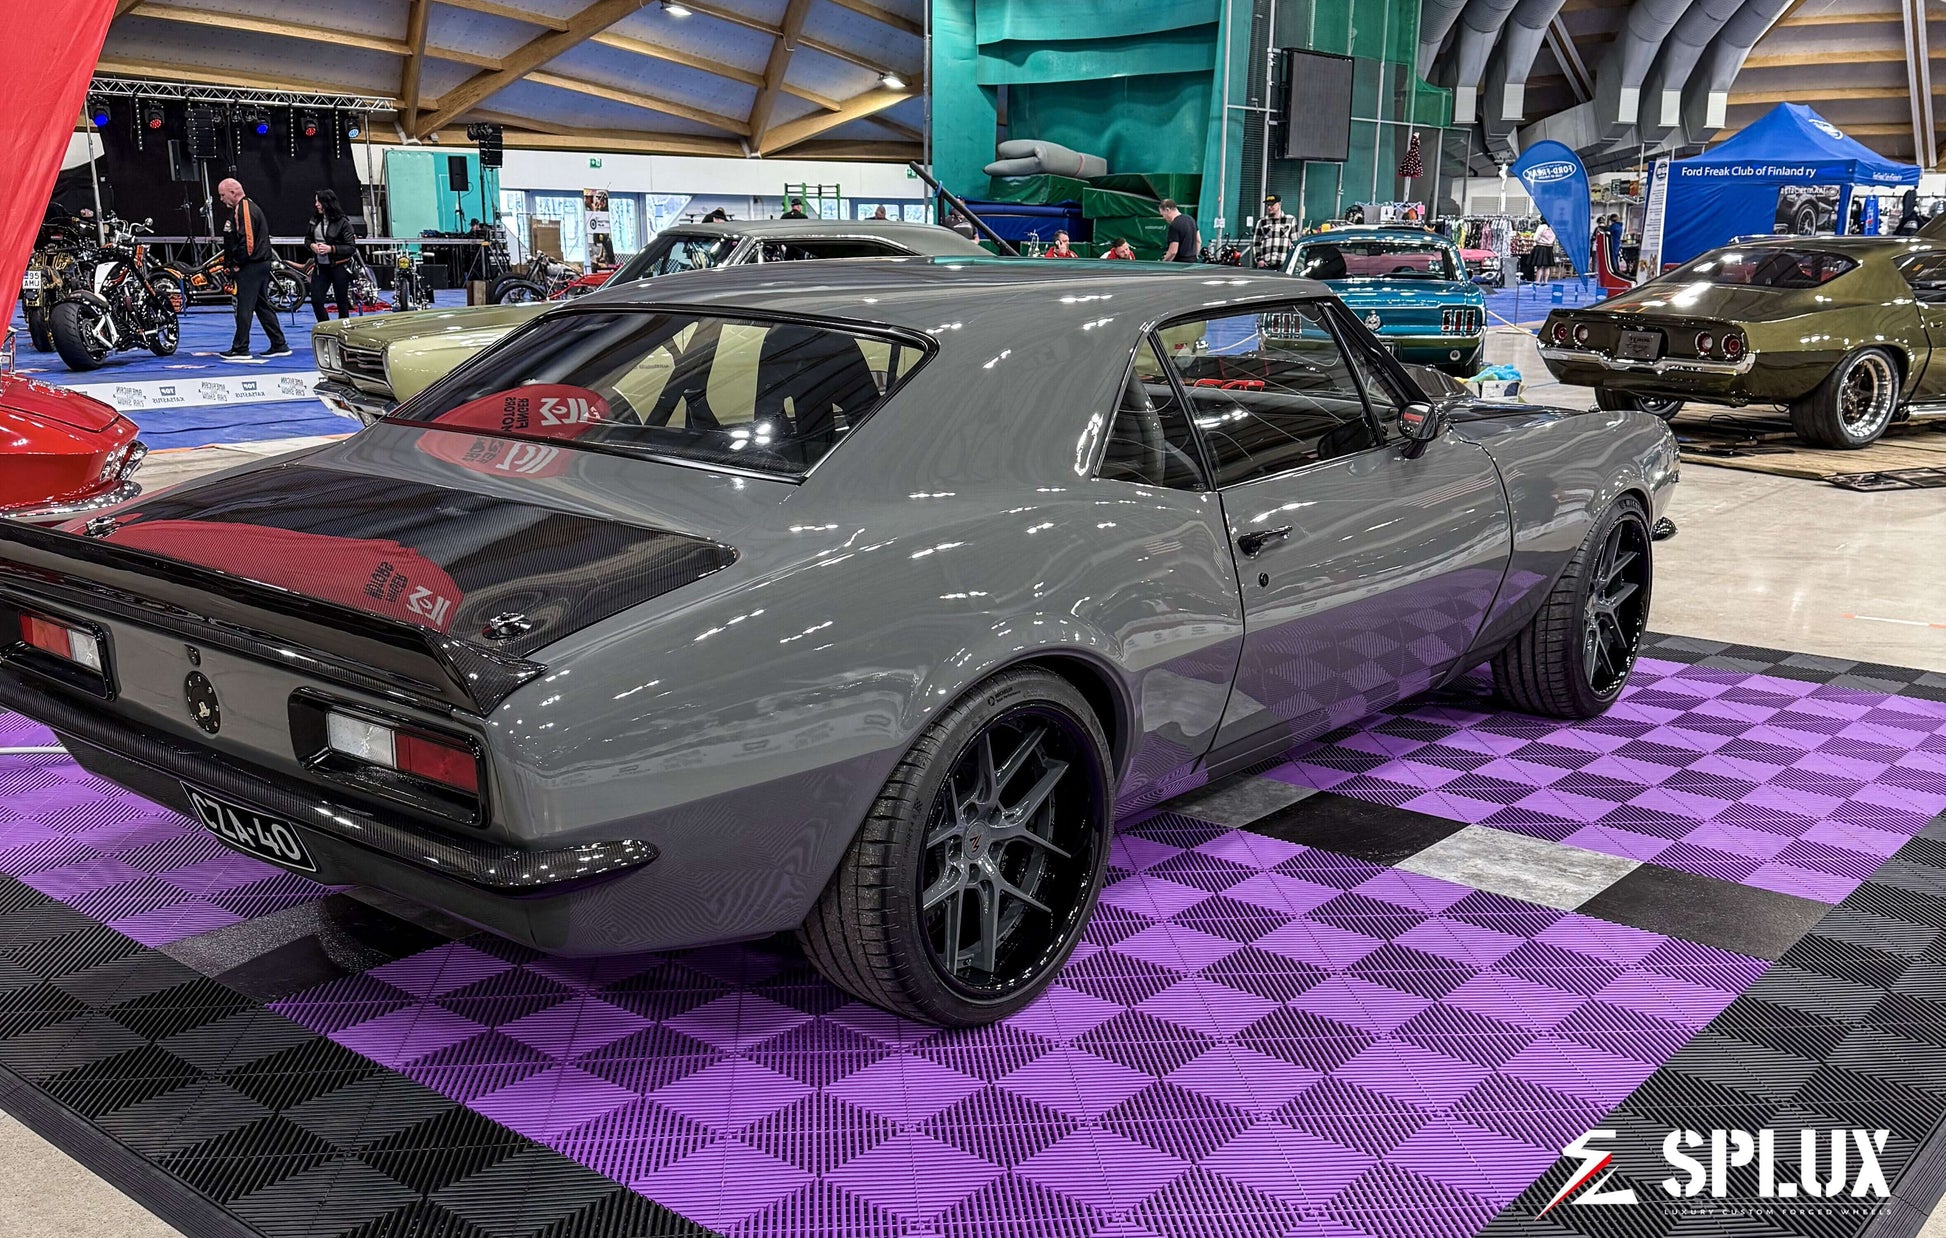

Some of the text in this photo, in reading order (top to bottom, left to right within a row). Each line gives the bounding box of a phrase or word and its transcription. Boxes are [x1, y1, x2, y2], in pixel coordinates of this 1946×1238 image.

[1681, 166, 1817, 178] Ford Freak Club of Finland ry
[191, 792, 302, 861] CZA-40
